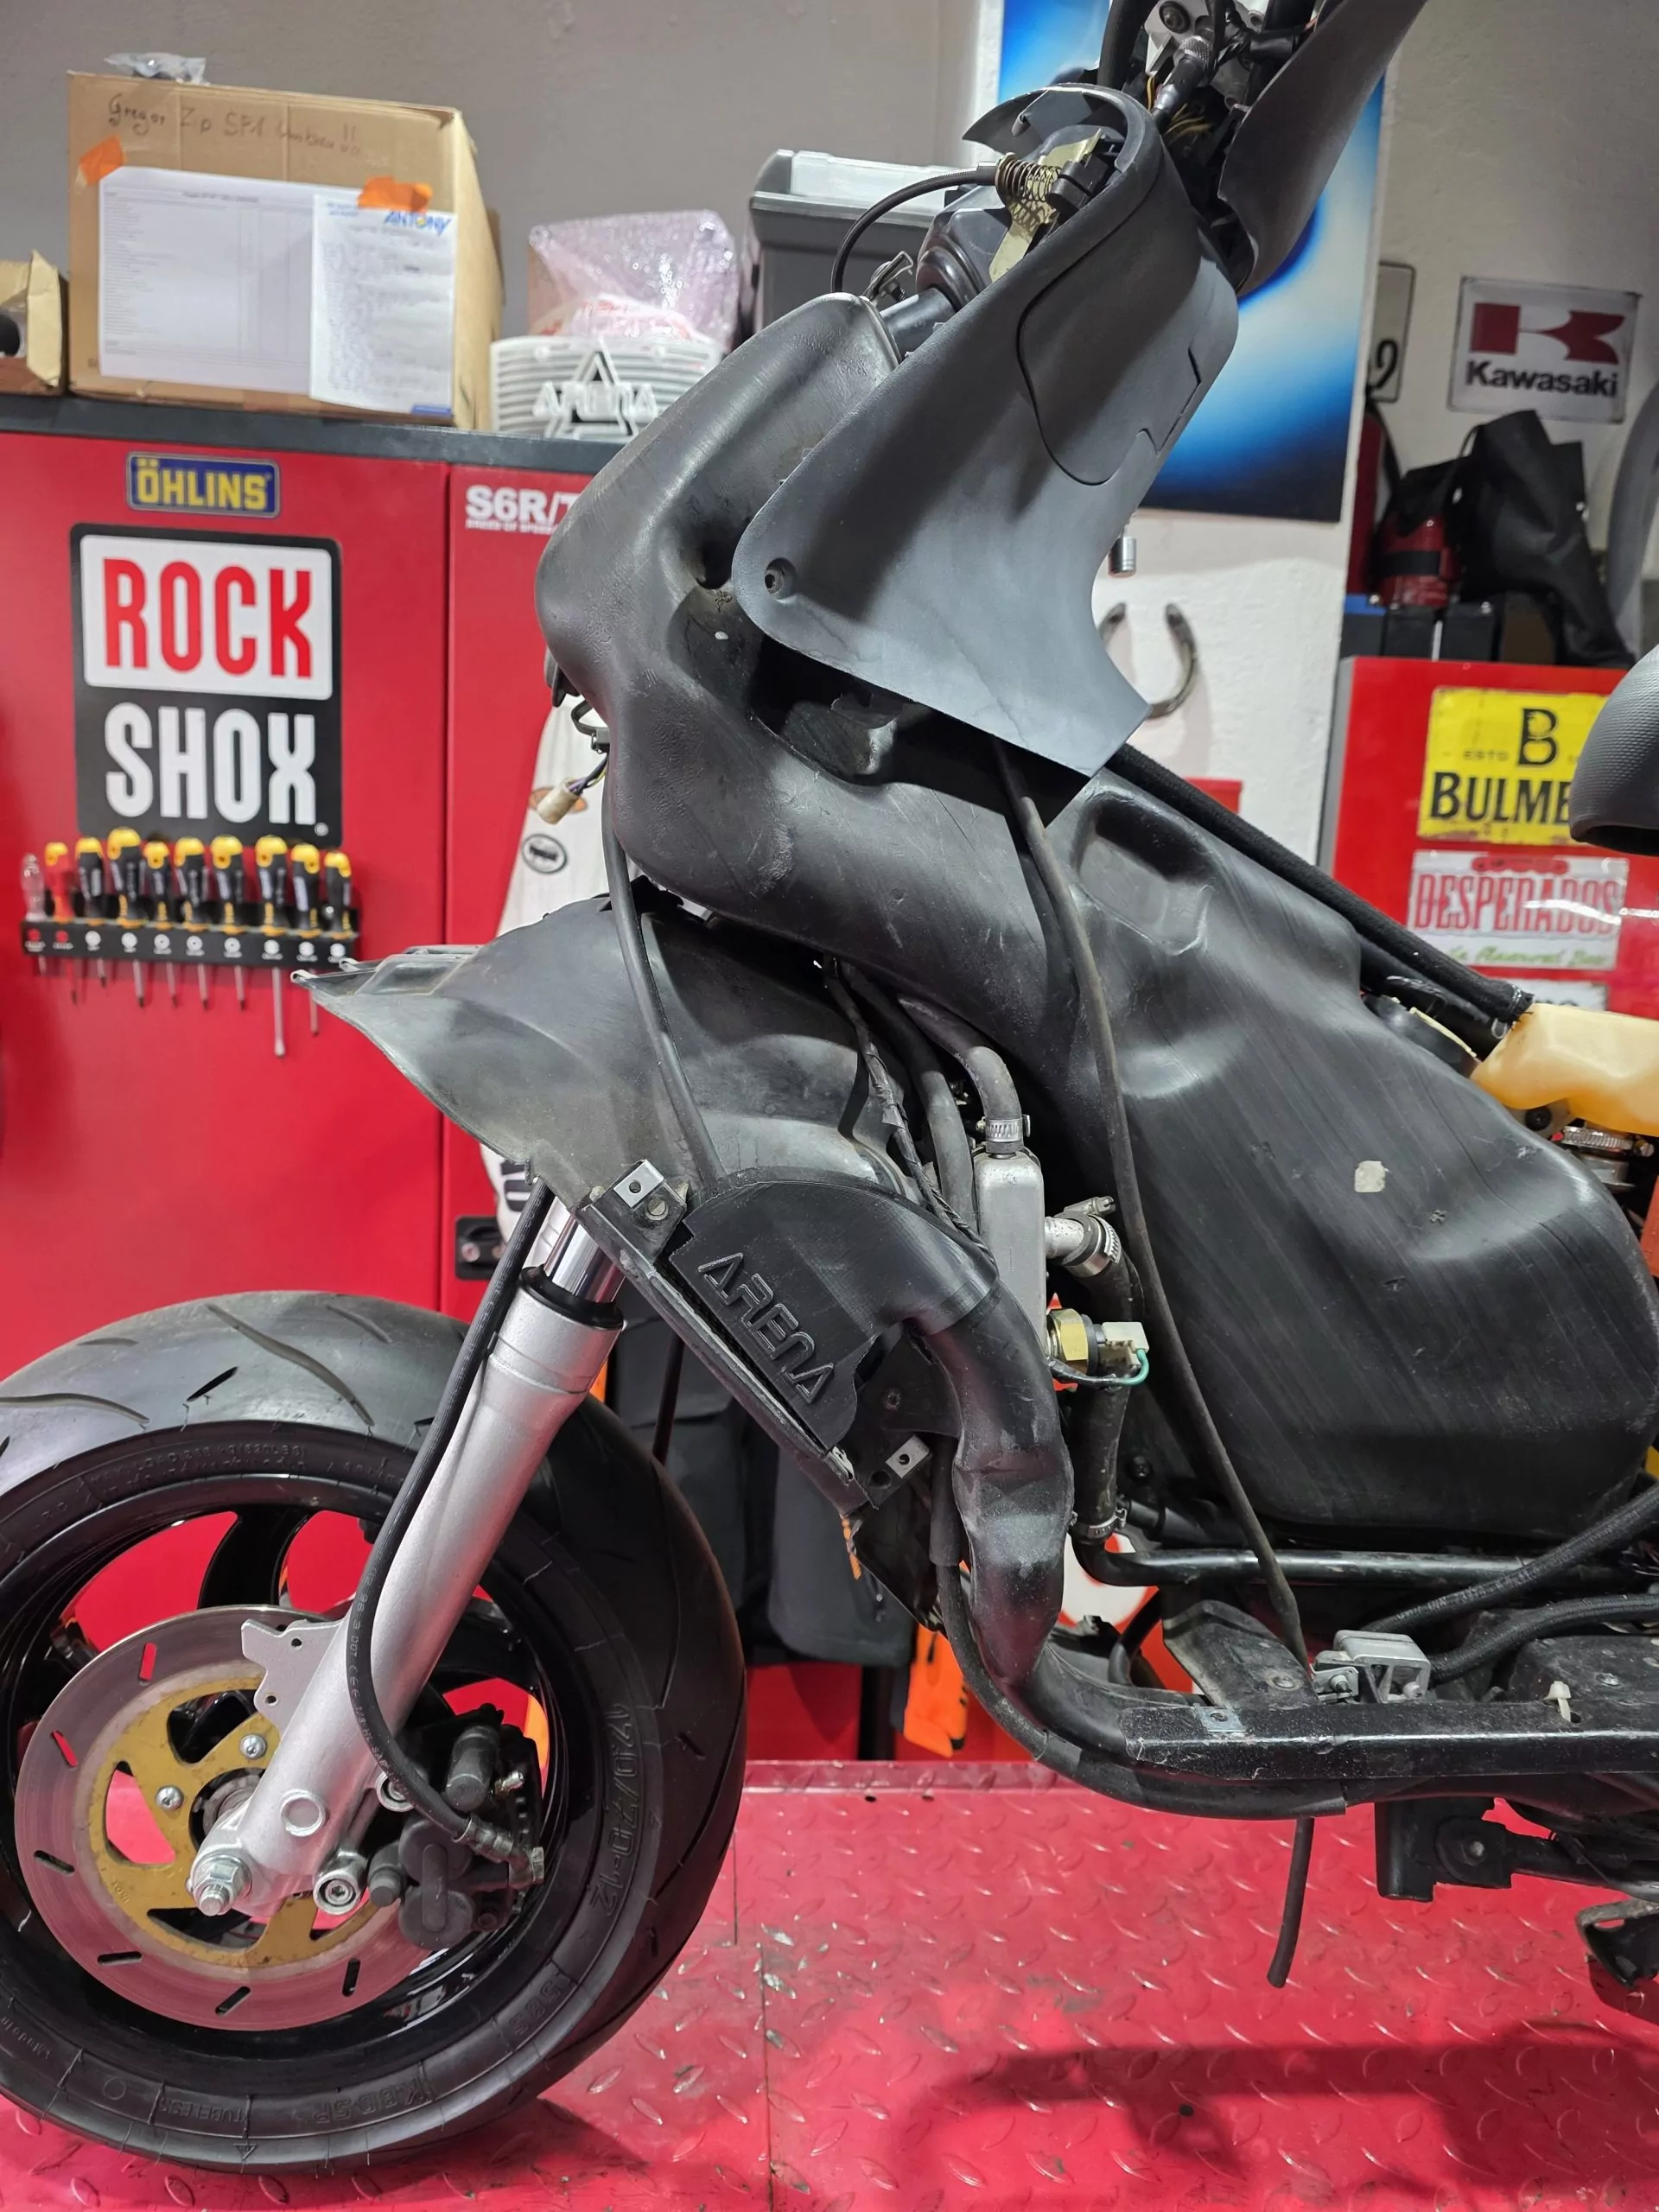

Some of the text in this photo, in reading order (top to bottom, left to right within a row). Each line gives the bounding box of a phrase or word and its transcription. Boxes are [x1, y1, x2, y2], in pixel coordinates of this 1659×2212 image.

[384, 210, 452, 237] ANTONY
[1465, 359, 1618, 398] Kawasaki
[137, 457, 267, 511] ÖHLINS
[103, 556, 313, 678] ROCK
[105, 702, 316, 826] SHOX
[1517, 708, 1558, 766] B
[1414, 873, 1619, 936] DESPERADOS
[698, 1252, 836, 1404] ARENA
[159, 2096, 251, 2126] TUBELESS
